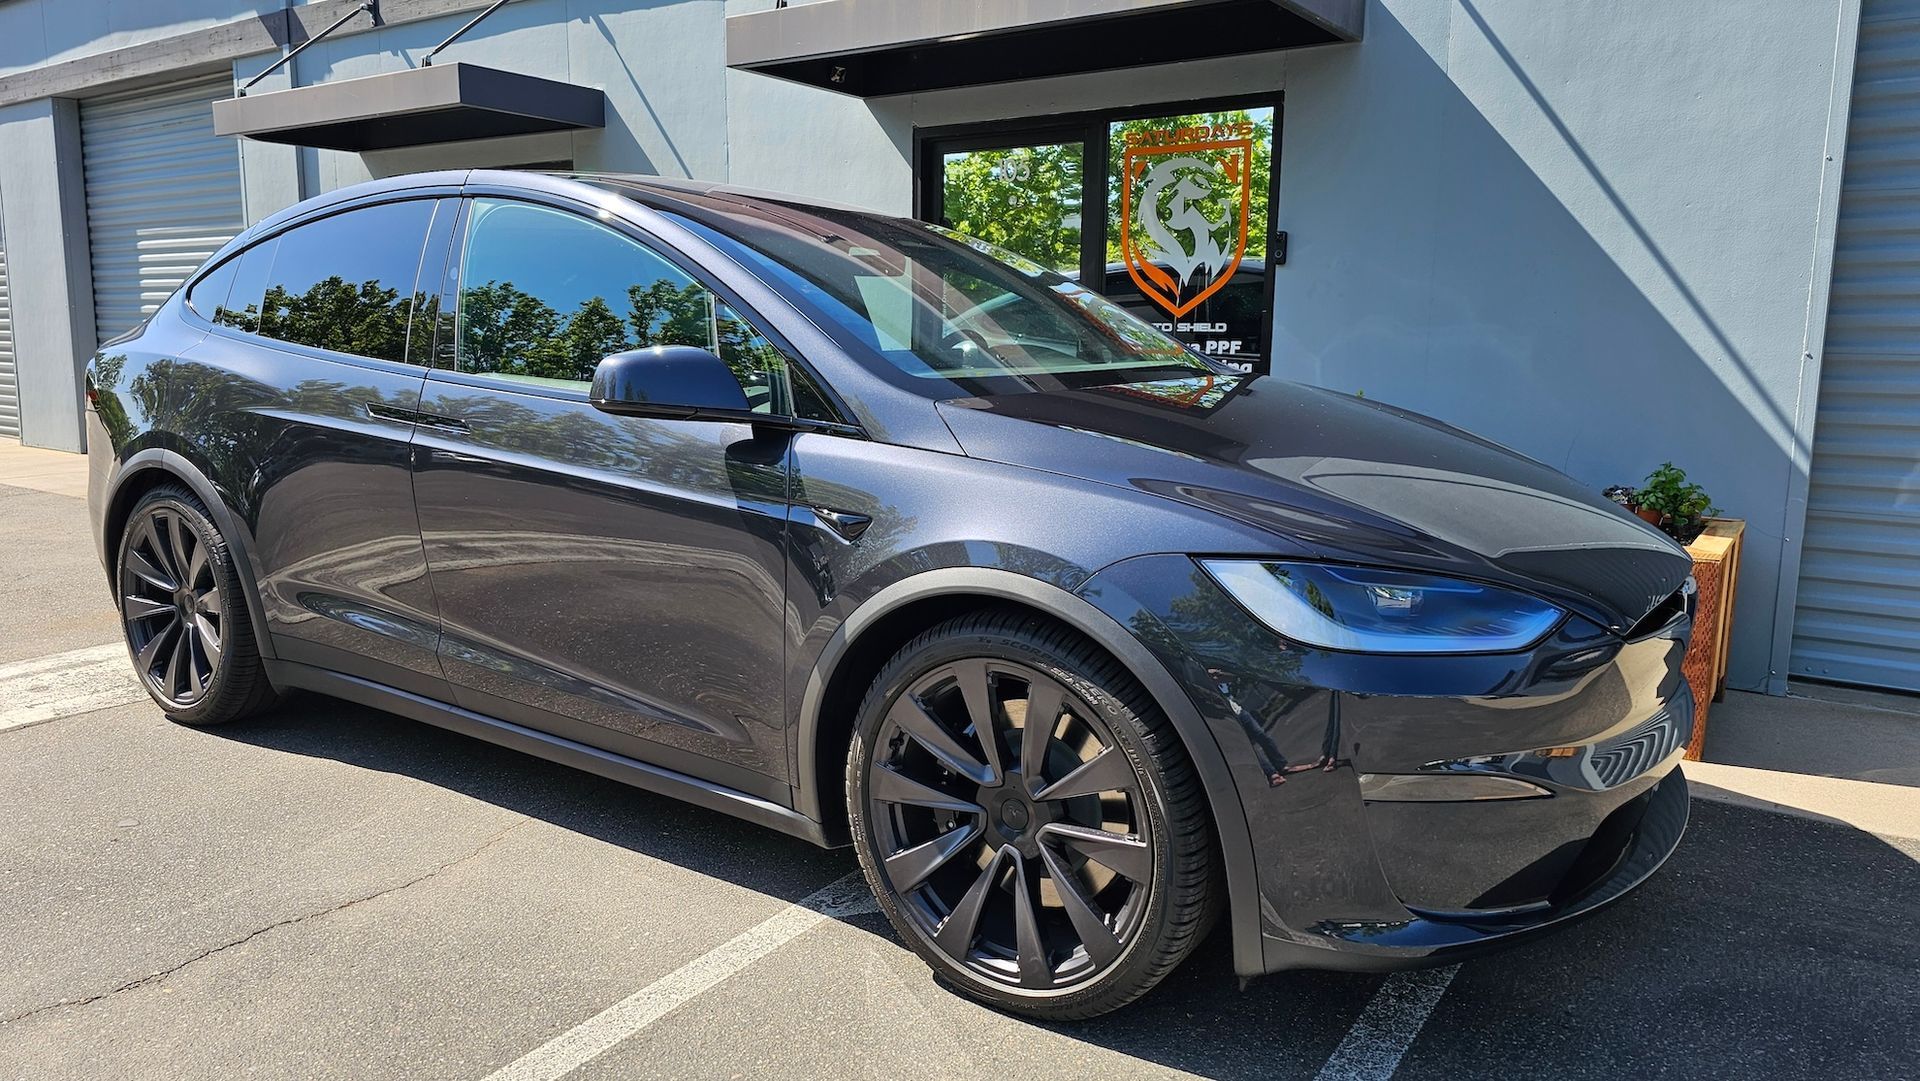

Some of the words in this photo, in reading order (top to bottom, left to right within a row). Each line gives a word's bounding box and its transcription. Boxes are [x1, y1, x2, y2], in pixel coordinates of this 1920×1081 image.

[1125, 121, 1253, 145] SATURDAYS
[998, 157, 1030, 181] 105
[1176, 322, 1228, 332] SHIELD
[1205, 340, 1242, 355] PPF
